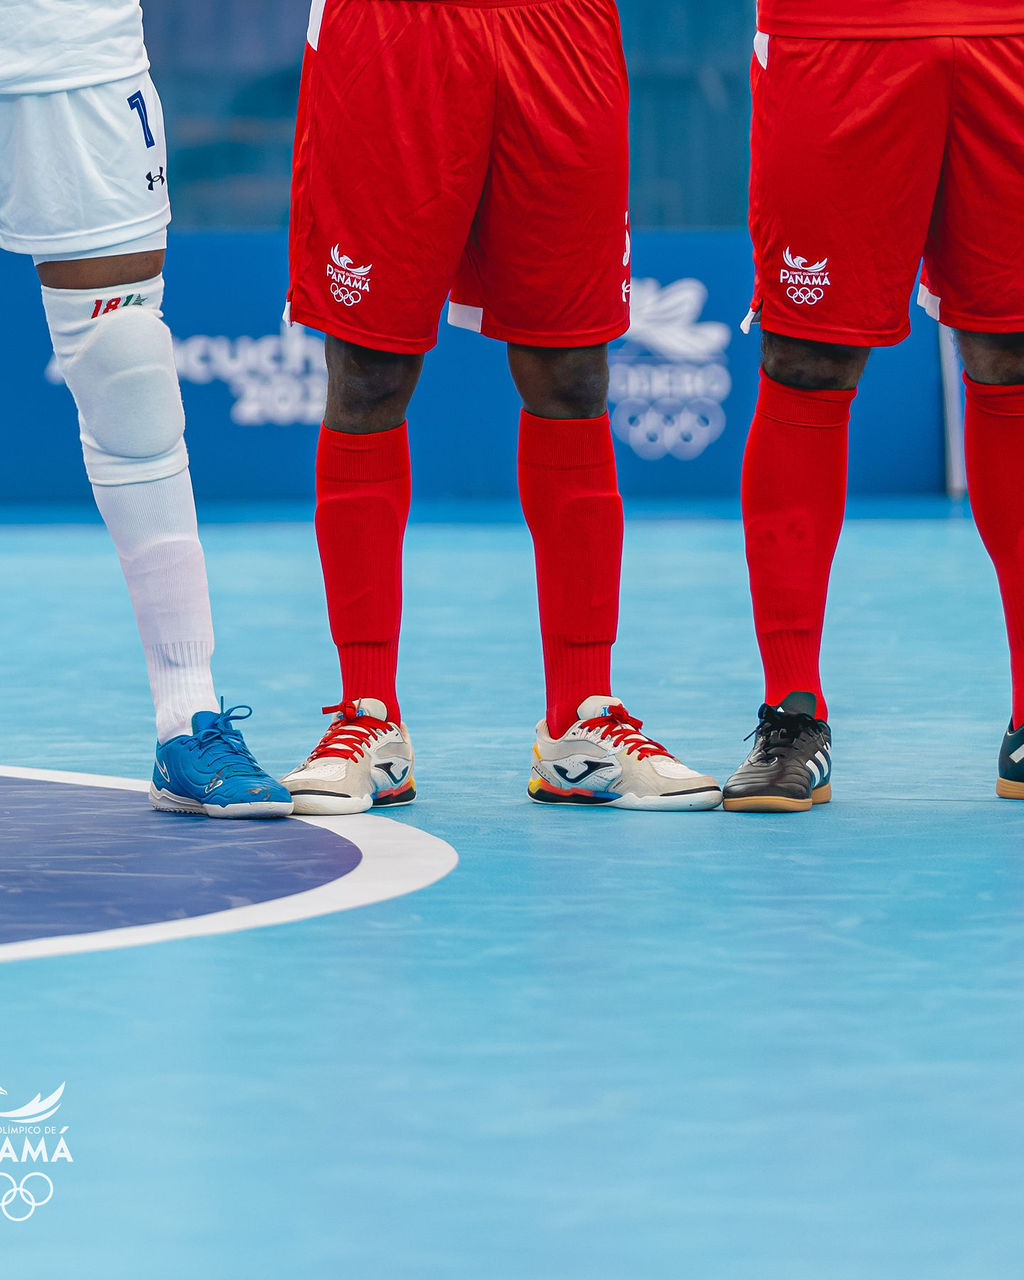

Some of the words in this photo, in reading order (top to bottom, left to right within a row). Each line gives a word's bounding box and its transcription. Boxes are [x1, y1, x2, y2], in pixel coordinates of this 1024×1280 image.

[126, 89, 156, 149] 1
[326, 263, 371, 293] PANAMÁ
[779, 268, 831, 286] PANAMÁ
